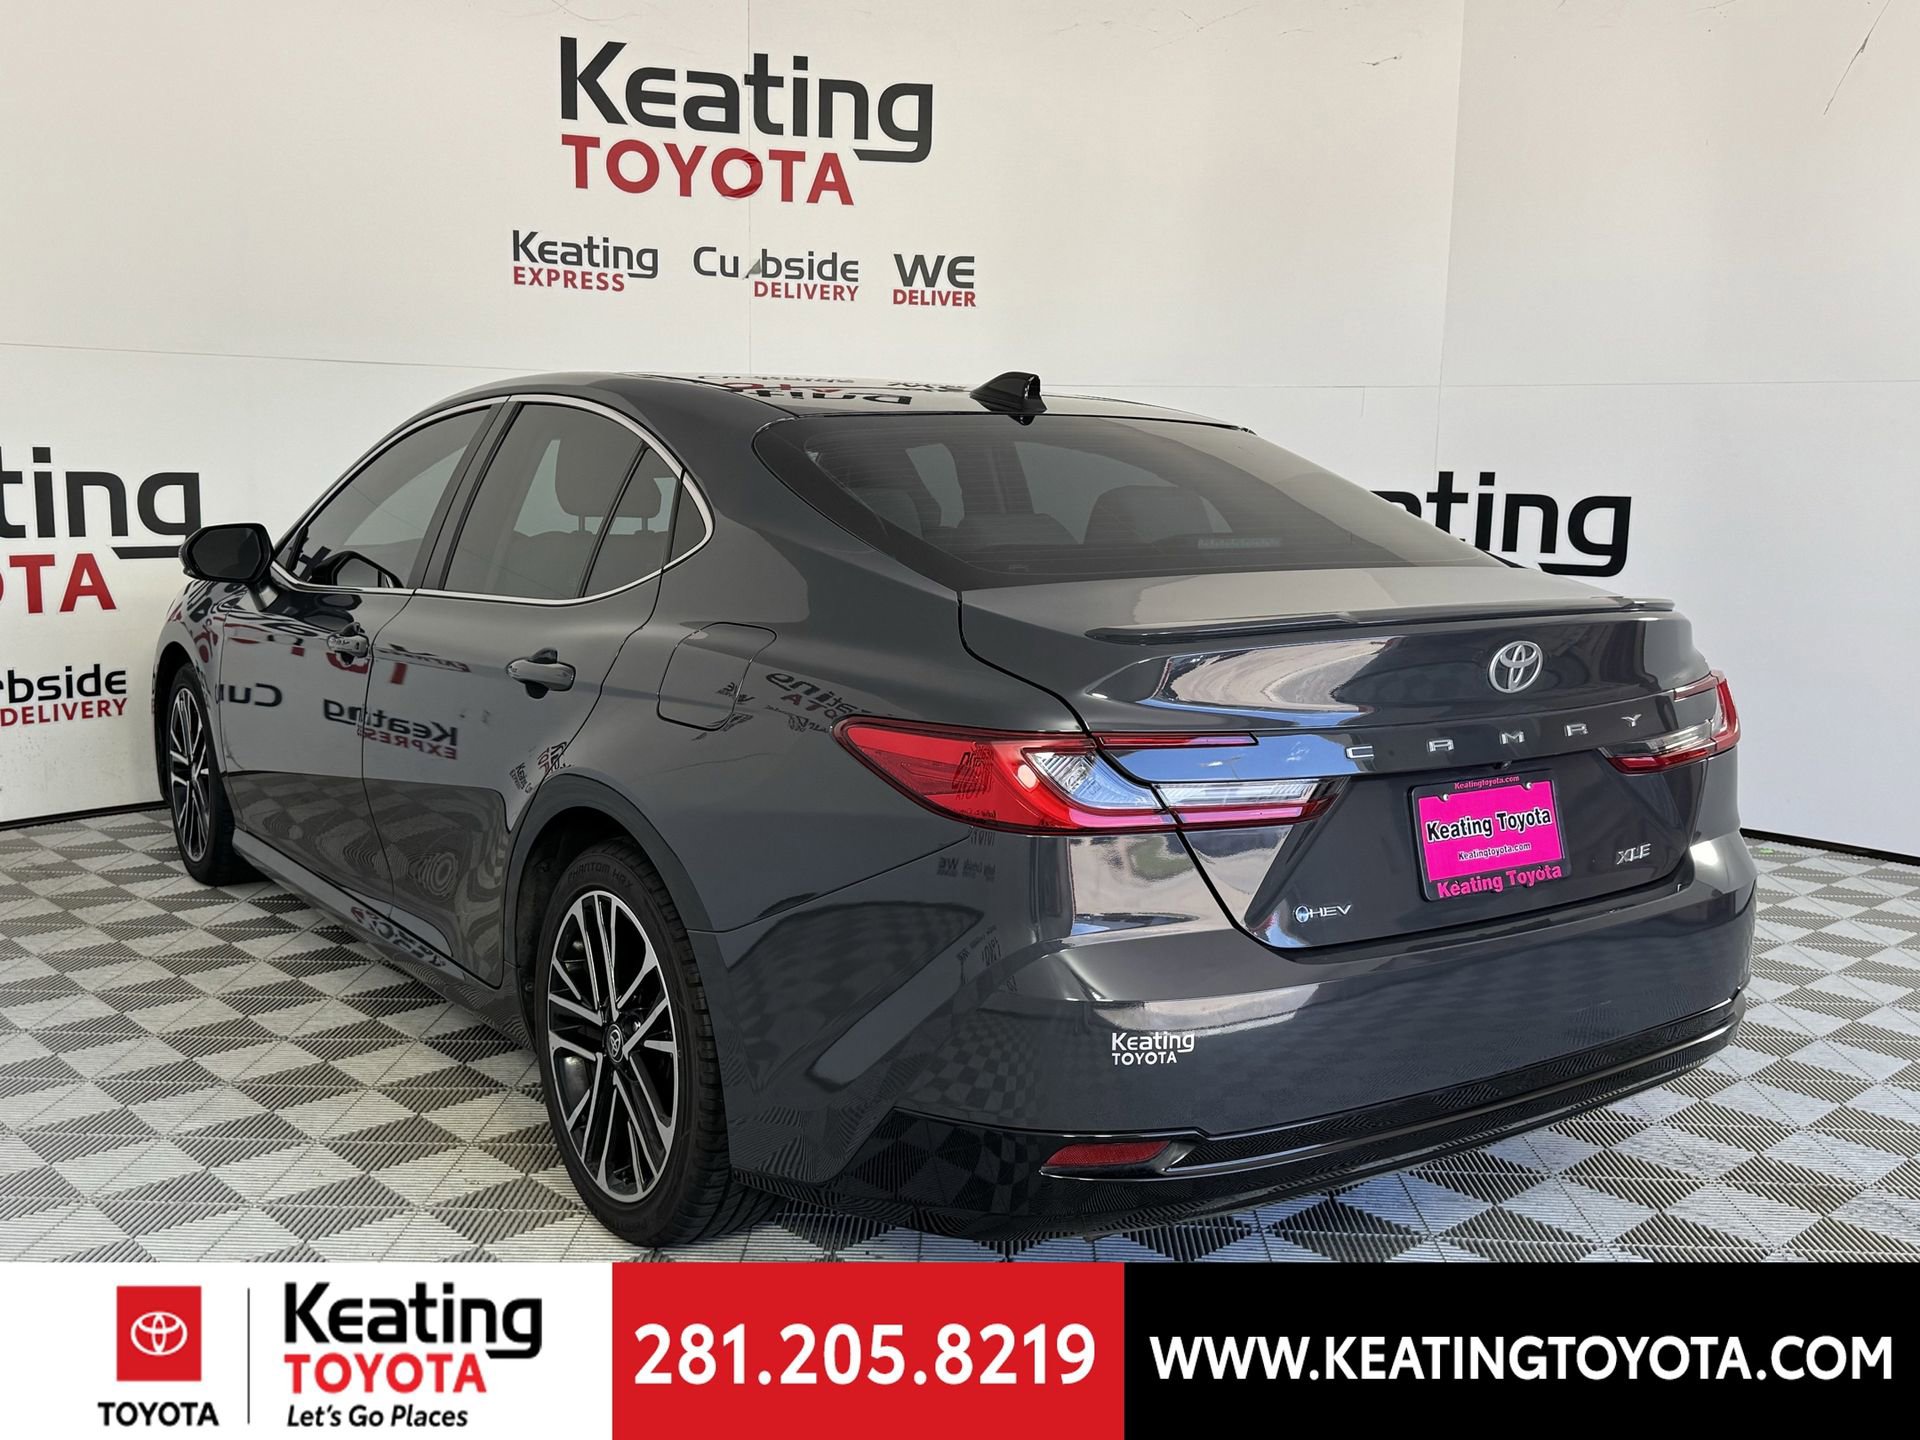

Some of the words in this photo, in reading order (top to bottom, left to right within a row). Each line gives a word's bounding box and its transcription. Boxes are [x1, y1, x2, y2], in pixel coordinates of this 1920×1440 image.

[560, 36, 933, 163] Keating
[561, 134, 855, 206] TOYOTA
[512, 230, 658, 279] Keating
[693, 246, 859, 282] Cubside
[894, 253, 975, 290] WE
[513, 266, 625, 292] EXPRESS
[754, 281, 859, 302] DELIVERY
[893, 288, 976, 307] DELIVER
[0, 698, 128, 727] DELIVERY
[1345, 713, 1643, 761] CAMRY
[1426, 815, 1493, 842] Keating
[1497, 807, 1552, 832] Toyota
[1616, 843, 1651, 865] XLE
[1437, 875, 1503, 899] Keating
[1506, 864, 1562, 887] Toyota
[1112, 1032, 1195, 1053] Keating
[1112, 1051, 1178, 1065] TOYOTA
